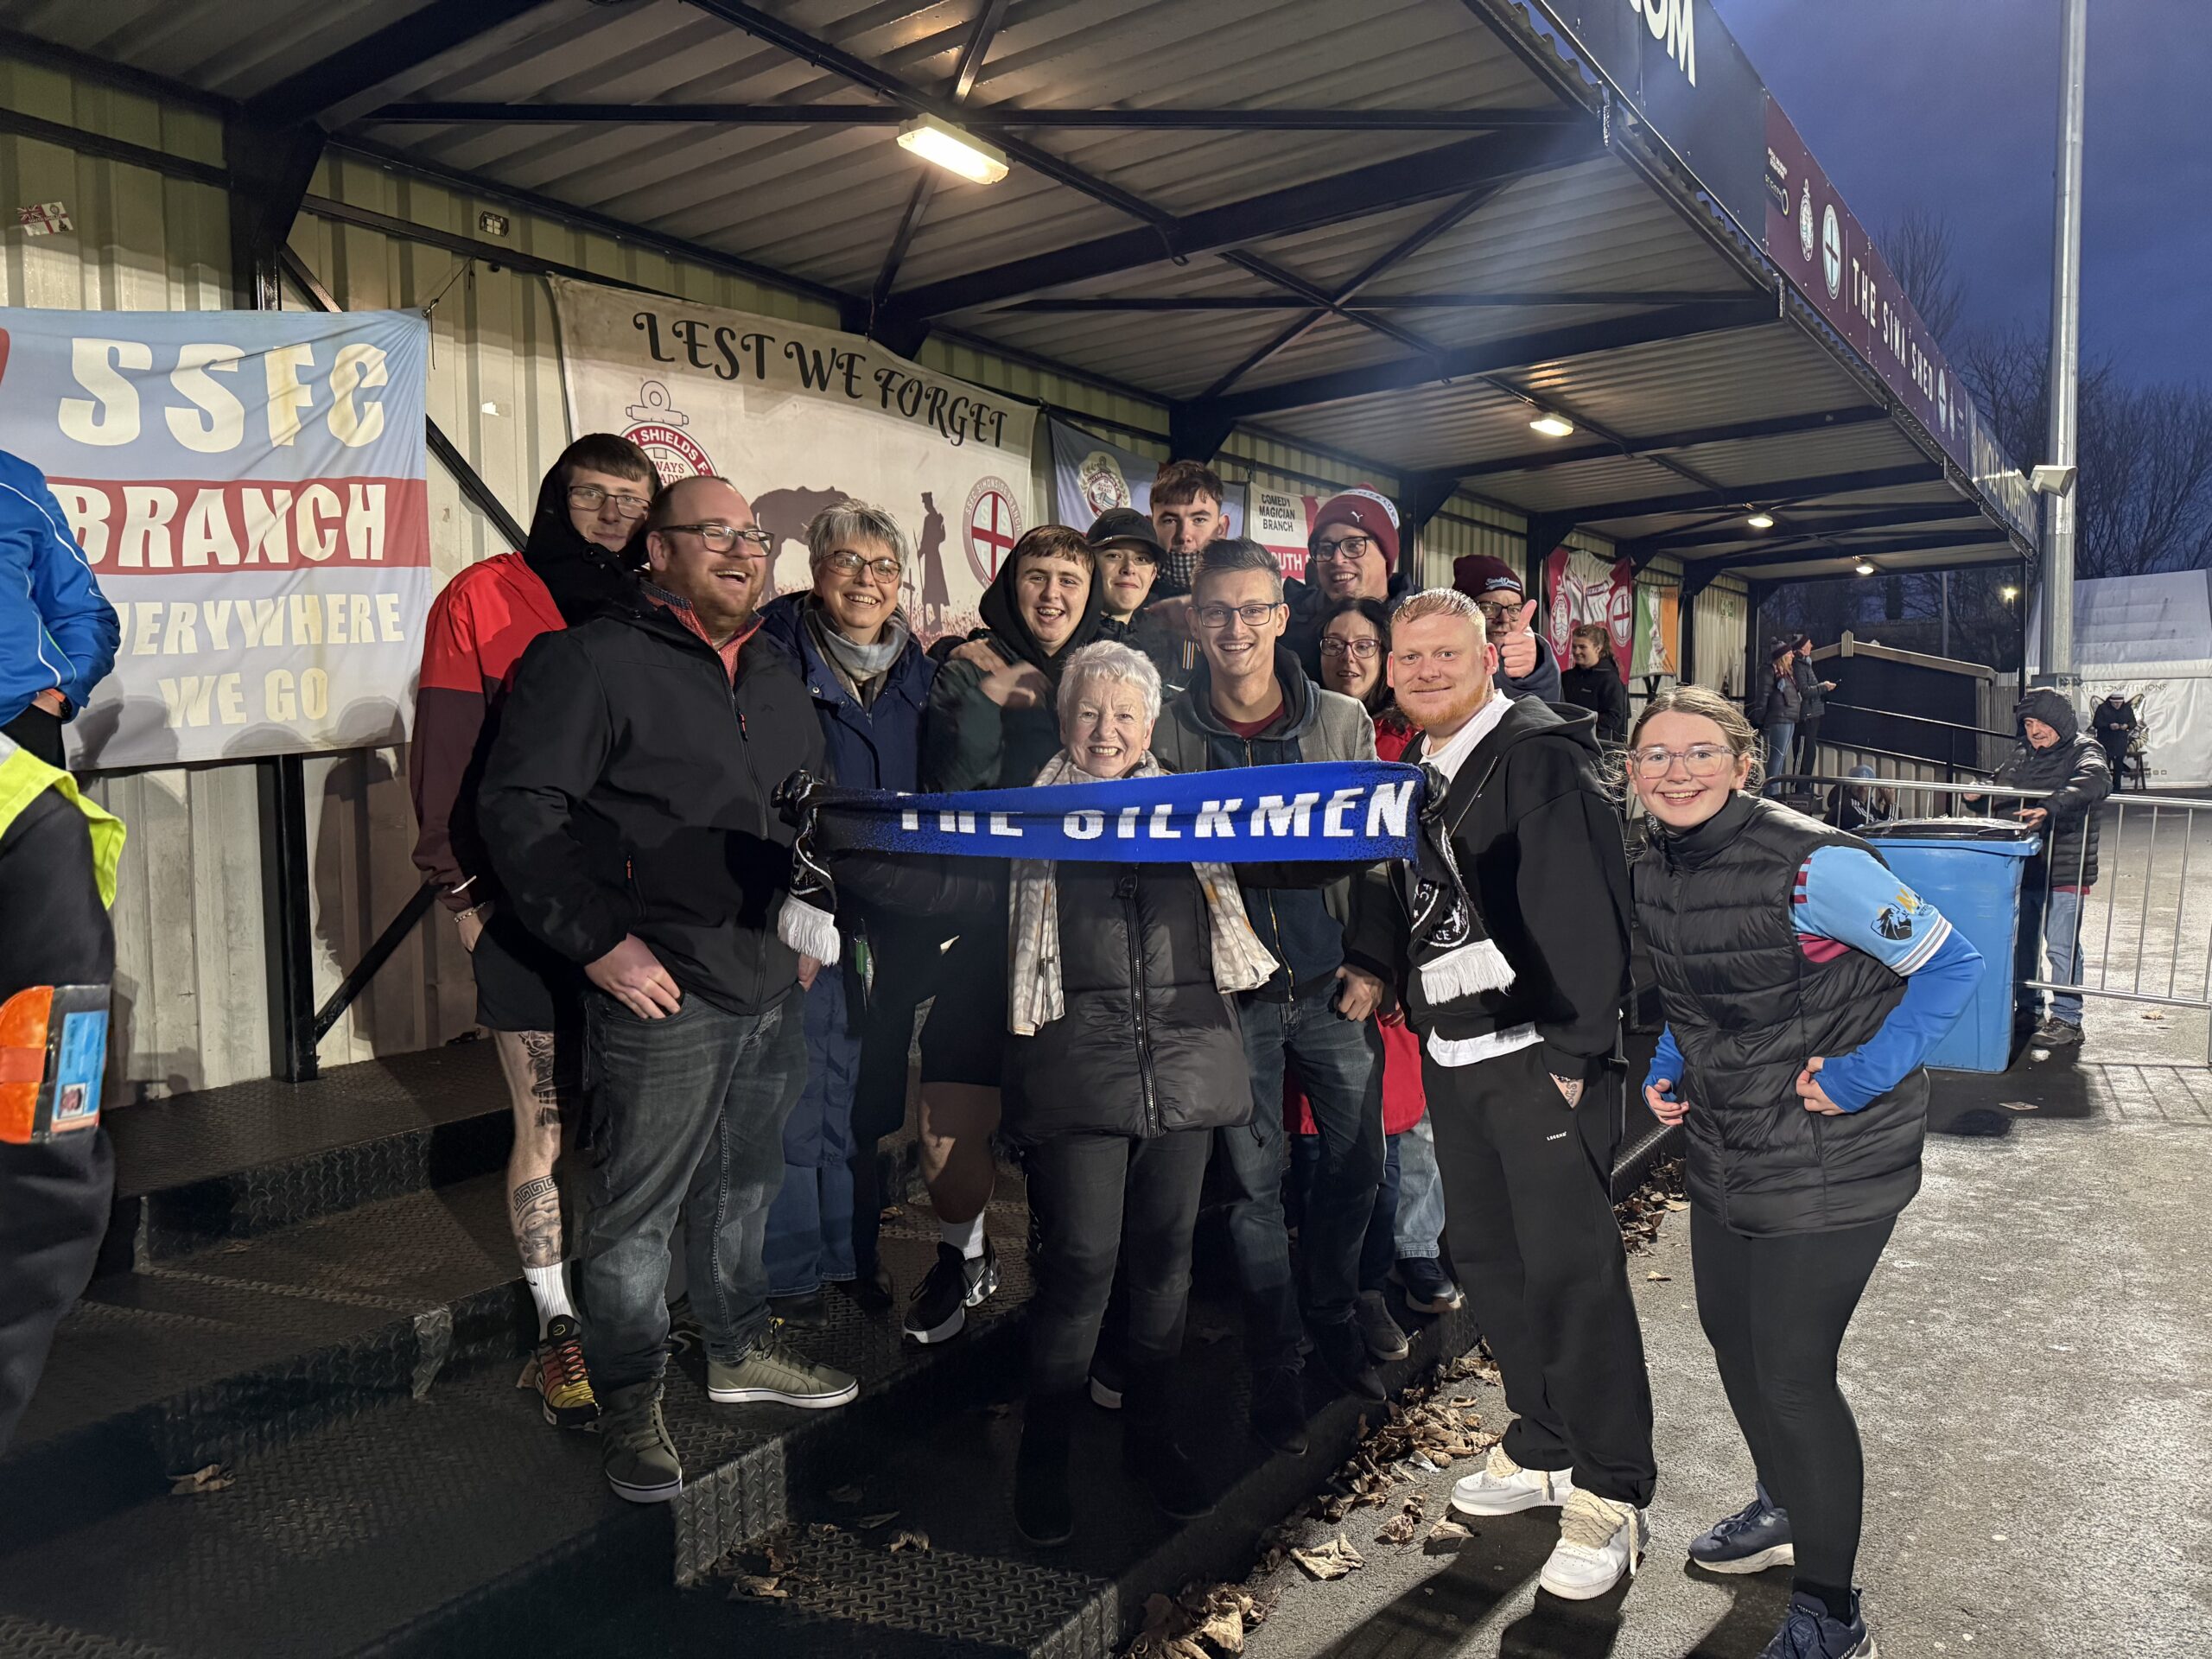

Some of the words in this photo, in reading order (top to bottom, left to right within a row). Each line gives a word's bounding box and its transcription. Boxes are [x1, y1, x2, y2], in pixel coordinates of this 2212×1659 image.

[1853, 257, 1876, 328] THE
[1911, 342, 1933, 402] SHED
[58, 337, 389, 453] SSFC
[632, 312, 776, 380] LEST
[785, 341, 867, 398] WE
[874, 367, 1008, 448] FORGET
[640, 429, 699, 461] SHIELDS
[656, 461, 684, 474] WAYS
[47, 483, 387, 568] BRANCH
[1259, 505, 1295, 520] MAGICIAN
[1262, 518, 1294, 532] BRANCH
[156, 672, 247, 728] WE
[264, 668, 328, 721] GO
